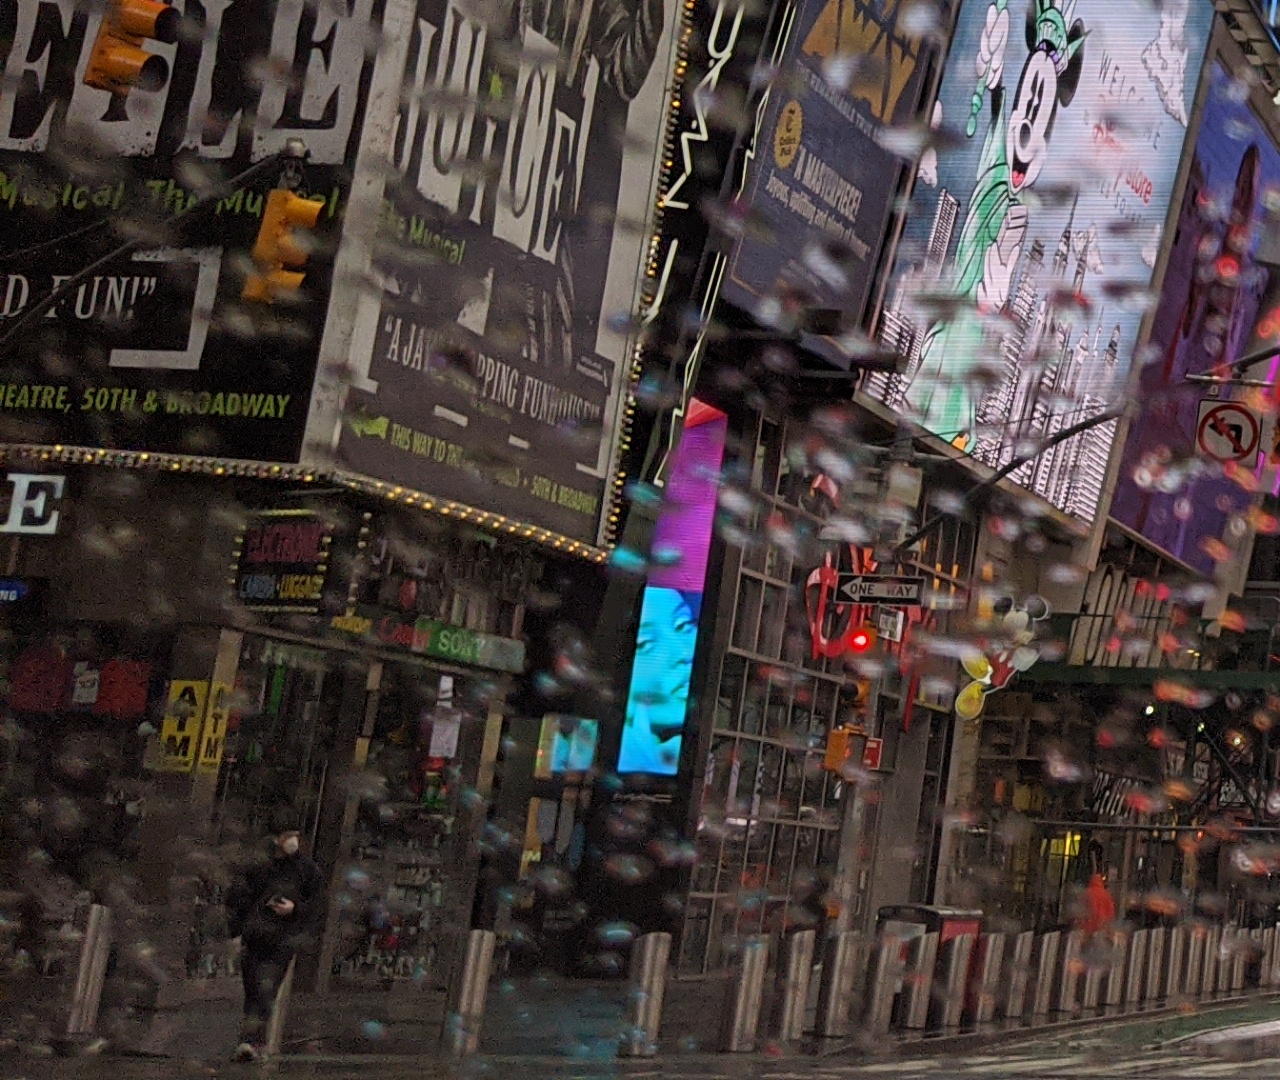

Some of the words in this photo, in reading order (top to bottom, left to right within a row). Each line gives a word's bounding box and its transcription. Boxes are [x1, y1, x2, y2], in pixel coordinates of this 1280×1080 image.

[81, 387, 138, 412] 50TH
[142, 390, 158, 412] &
[850, 582, 875, 595] ONE
[886, 583, 913, 596] WAY
